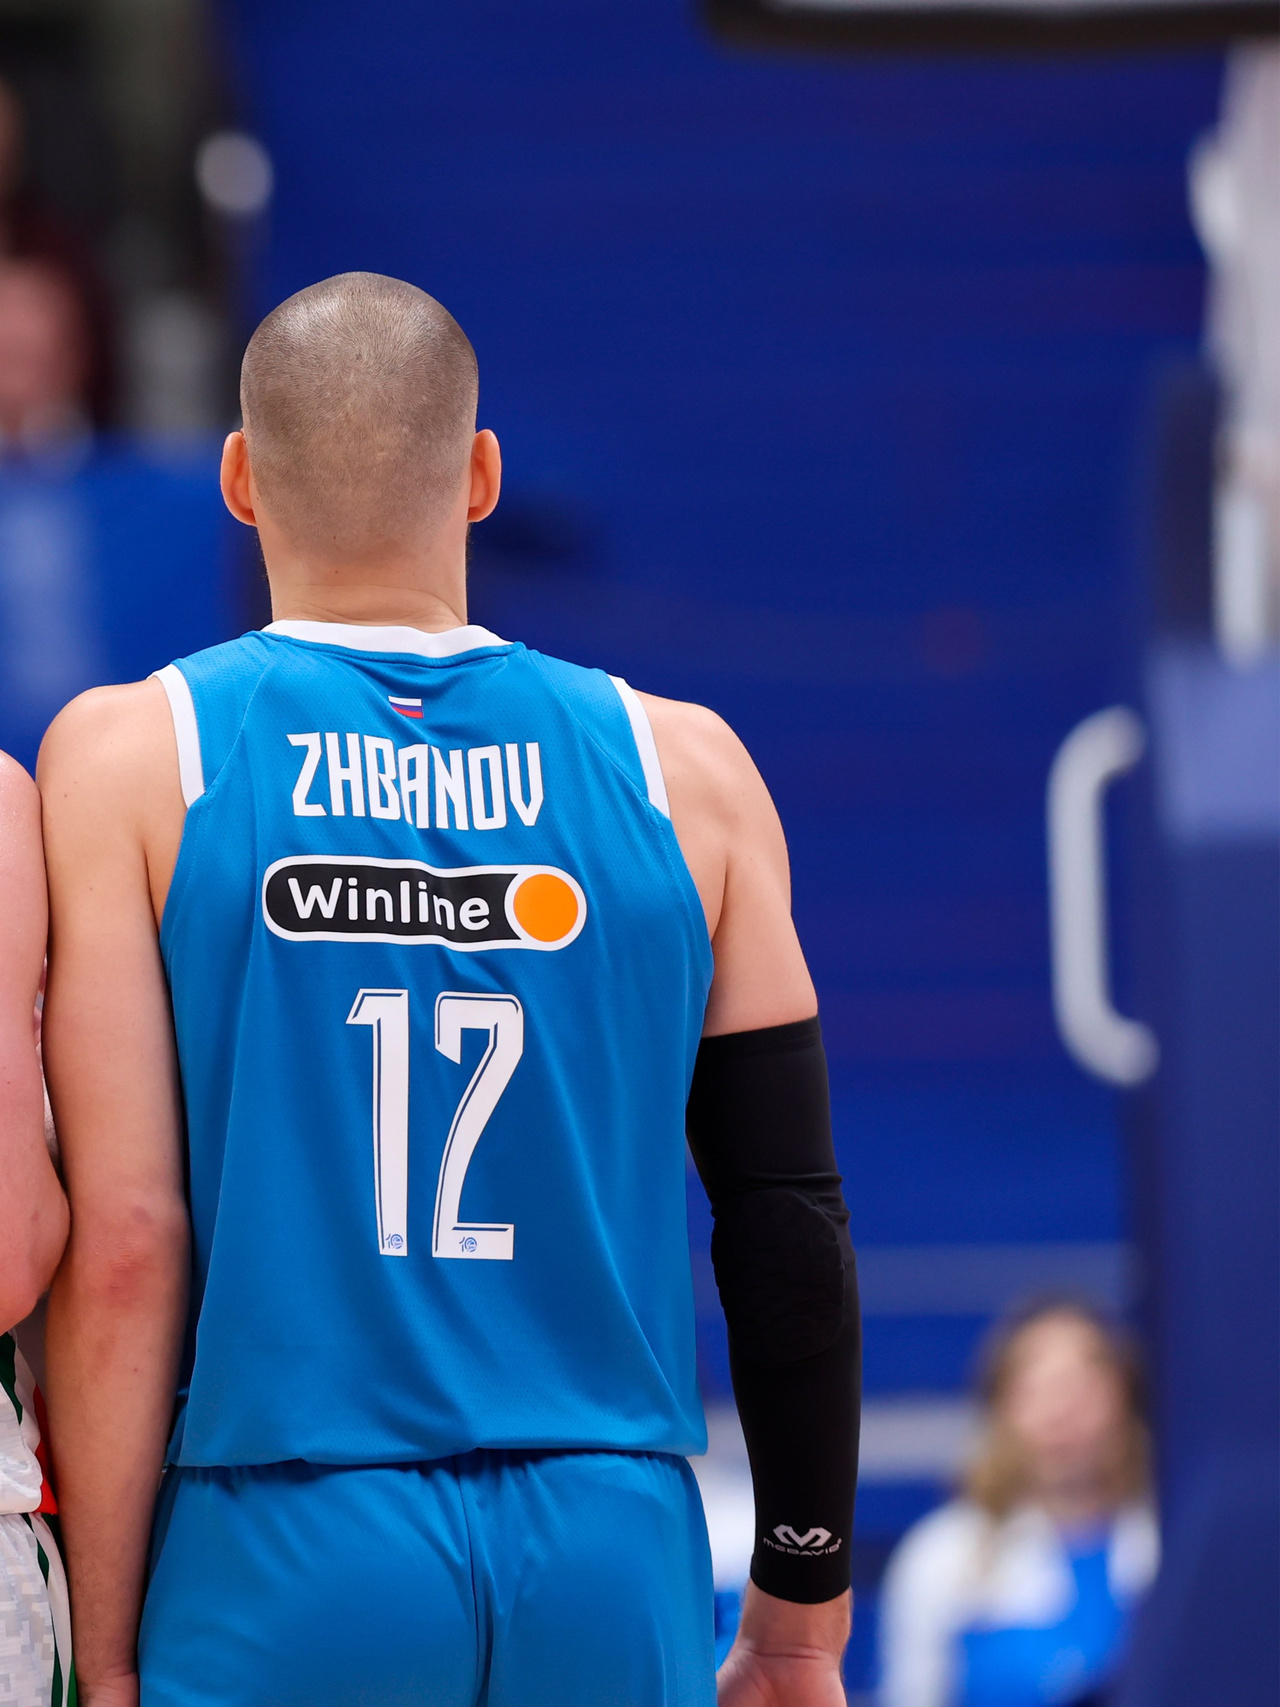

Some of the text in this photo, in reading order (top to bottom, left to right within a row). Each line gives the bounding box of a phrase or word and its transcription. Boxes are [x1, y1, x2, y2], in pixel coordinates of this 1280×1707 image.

[286, 731, 544, 831] ZHBANOV
[287, 877, 491, 931] Winline
[345, 988, 524, 1260] 12
